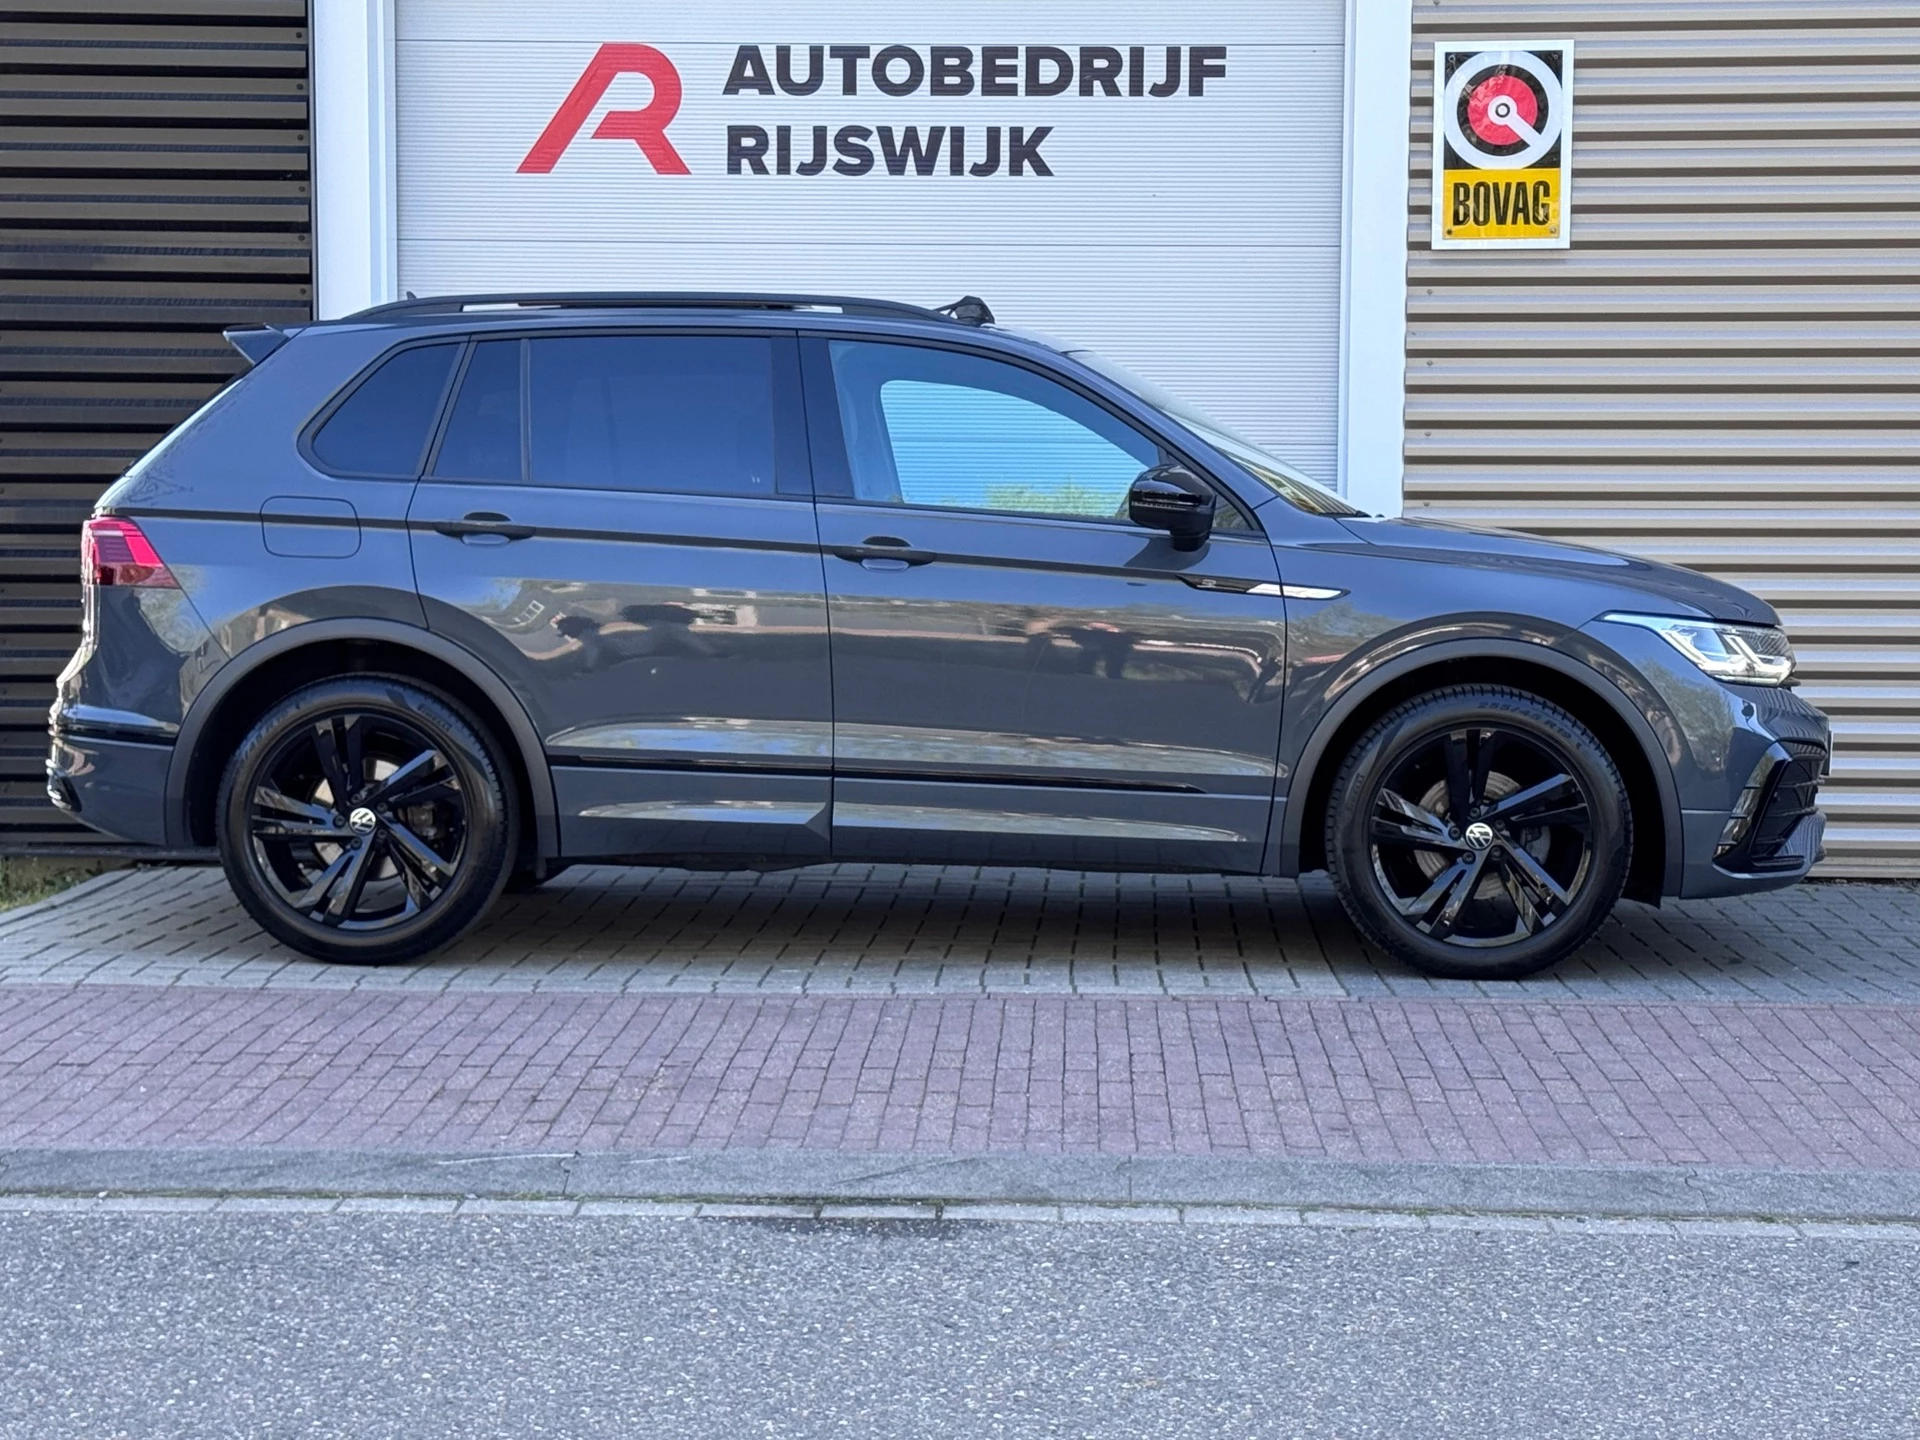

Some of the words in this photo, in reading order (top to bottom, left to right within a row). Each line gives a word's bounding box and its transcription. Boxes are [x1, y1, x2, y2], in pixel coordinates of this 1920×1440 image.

[723, 44, 1227, 97] AUTOBEDRIJF
[727, 125, 1054, 176] RIJSWIJK
[1453, 180, 1550, 226] BOVAG
